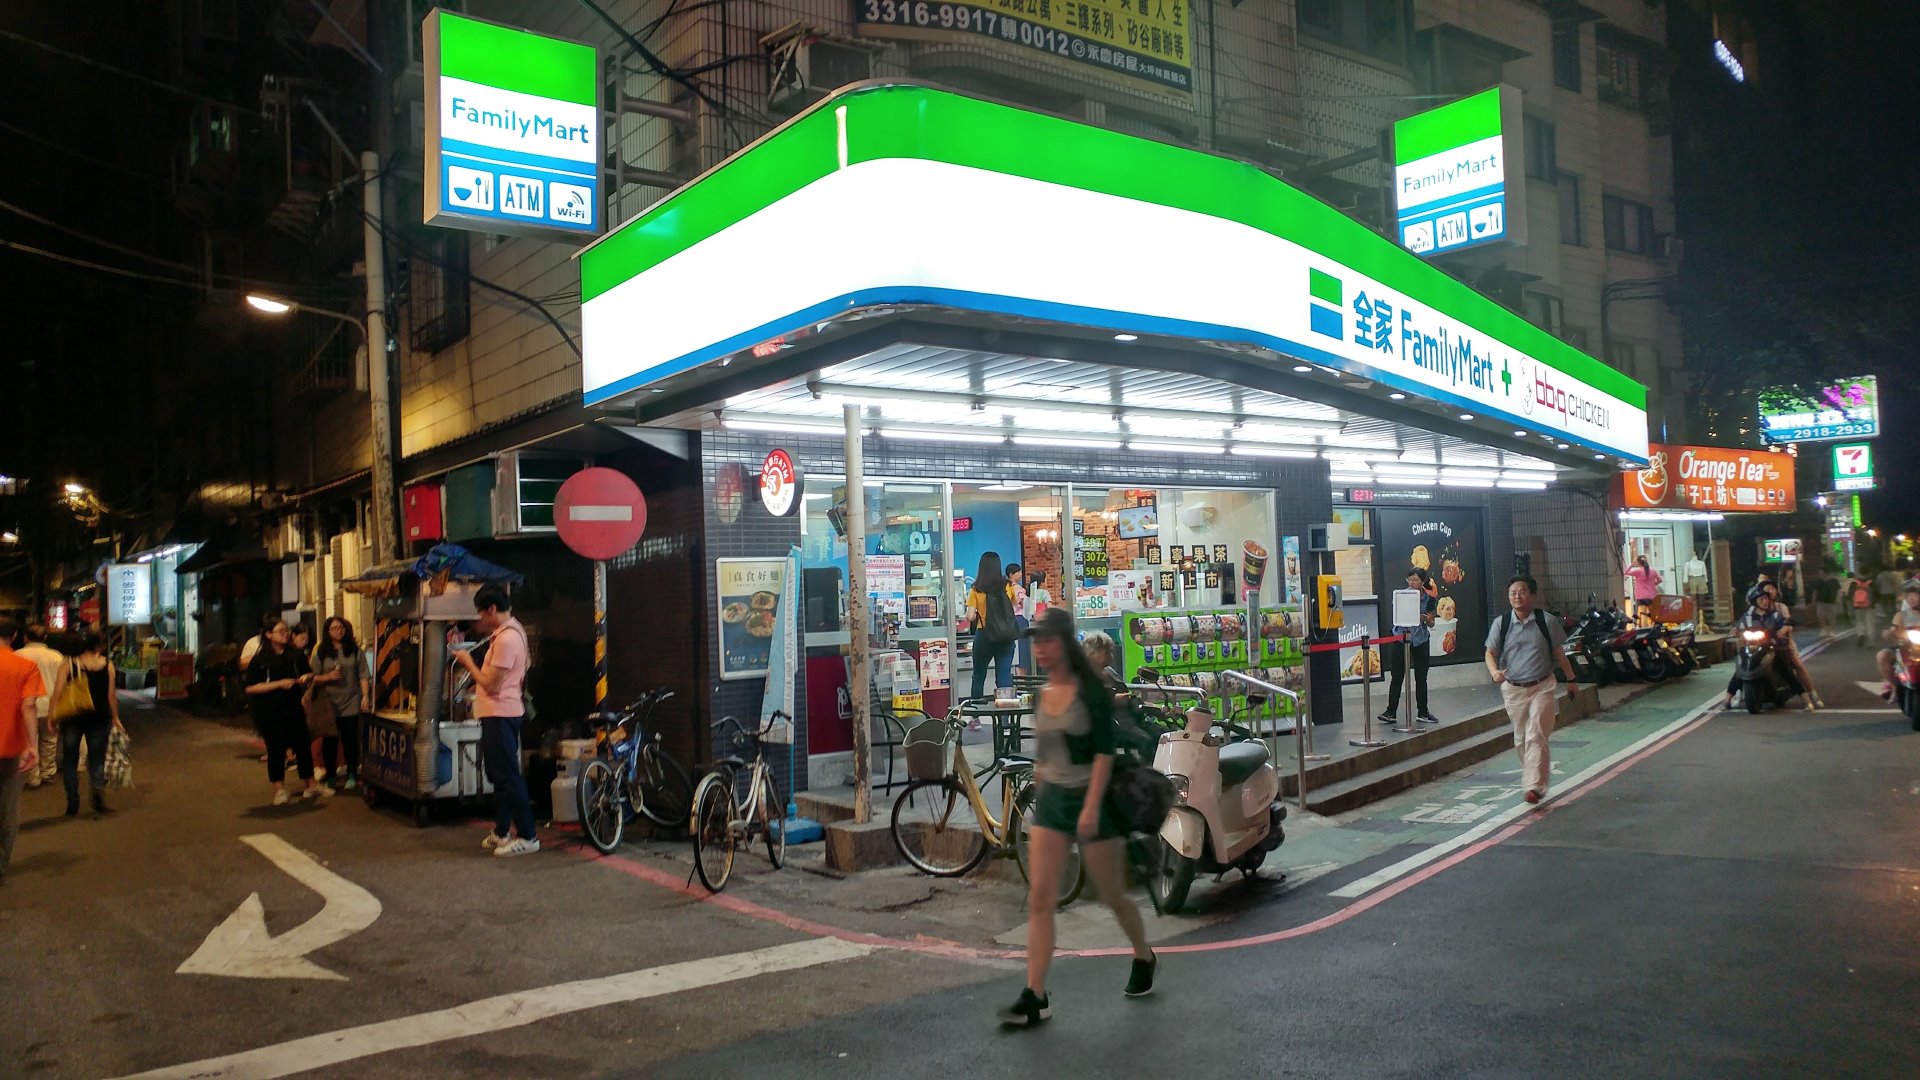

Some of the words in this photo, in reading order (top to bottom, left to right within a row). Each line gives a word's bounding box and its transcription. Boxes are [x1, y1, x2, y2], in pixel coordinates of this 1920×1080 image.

[452, 97, 589, 144] FamilyMart
[1403, 154, 1496, 193] FamilyMart
[505, 181, 540, 212] ATM
[557, 206, 585, 219] Wi-Fi
[1441, 217, 1465, 243] ATM
[1353, 290, 1393, 354] 全家
[1401, 308, 1494, 394] FamilyMart
[1568, 394, 1610, 429] CHICKEN
[1793, 423, 1873, 440] 2918-2933
[1679, 450, 1737, 486] Orange
[1739, 456, 1764, 482] Tea
[1412, 520, 1439, 536] Chicken
[1439, 521, 1452, 537] Cup
[1161, 571, 1218, 590] 新上市
